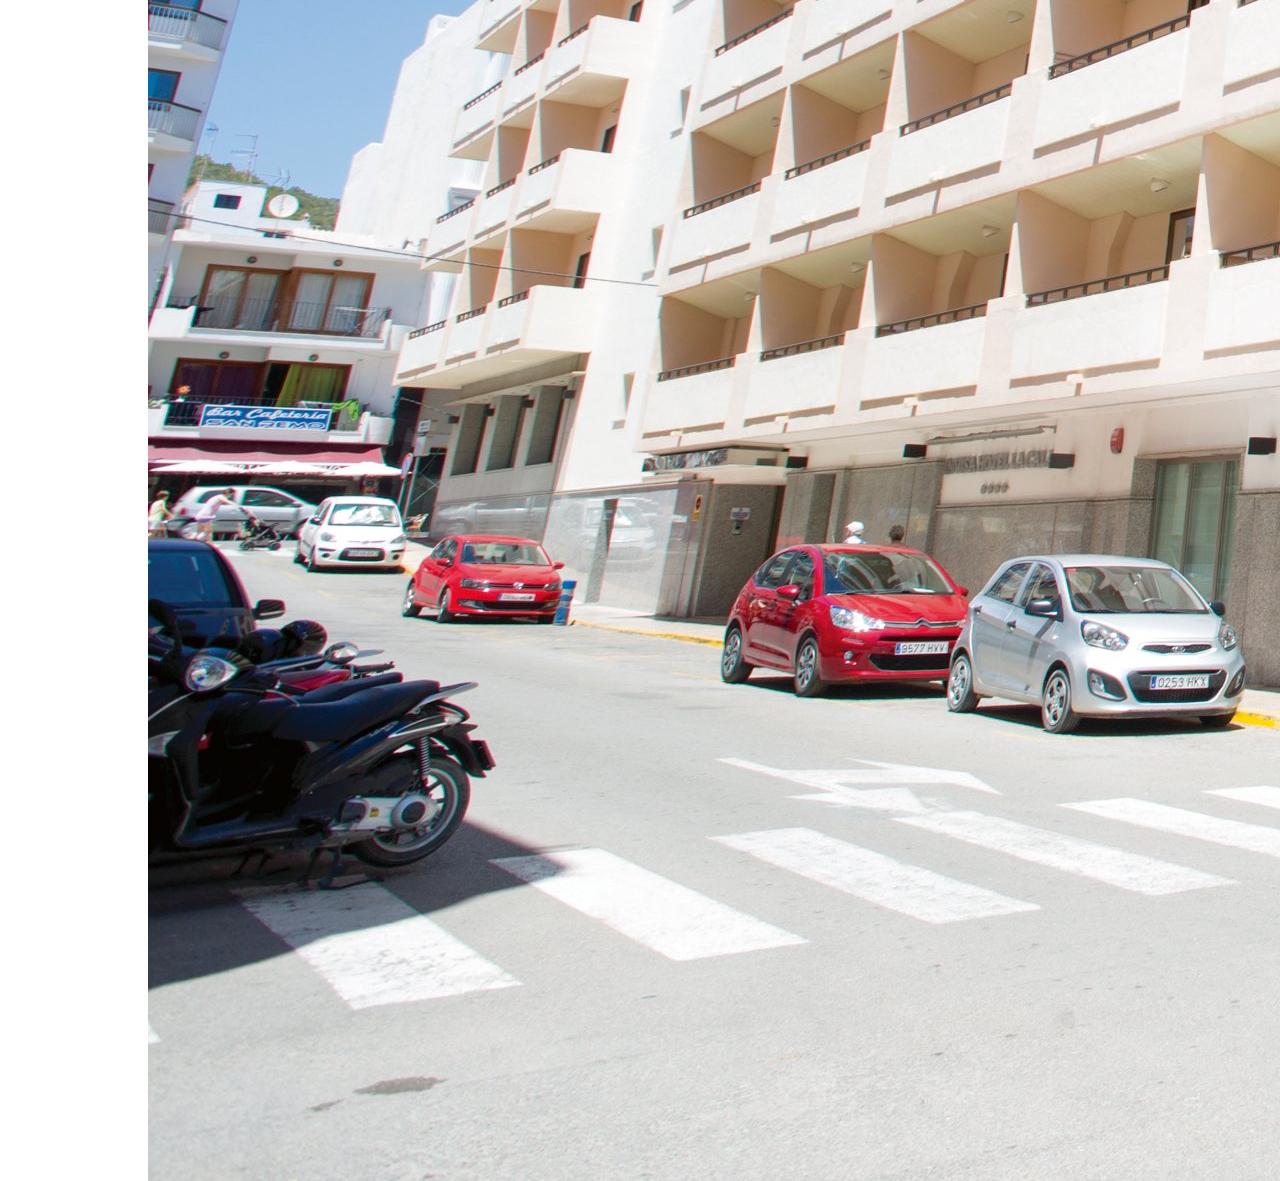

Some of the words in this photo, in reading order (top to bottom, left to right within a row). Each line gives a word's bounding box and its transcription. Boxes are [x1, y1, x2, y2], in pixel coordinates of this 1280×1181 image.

[206, 407, 242, 417] Bar
[206, 419, 256, 428] SAN
[1157, 676, 1185, 688] 0253
[1187, 676, 1207, 687] HKX
